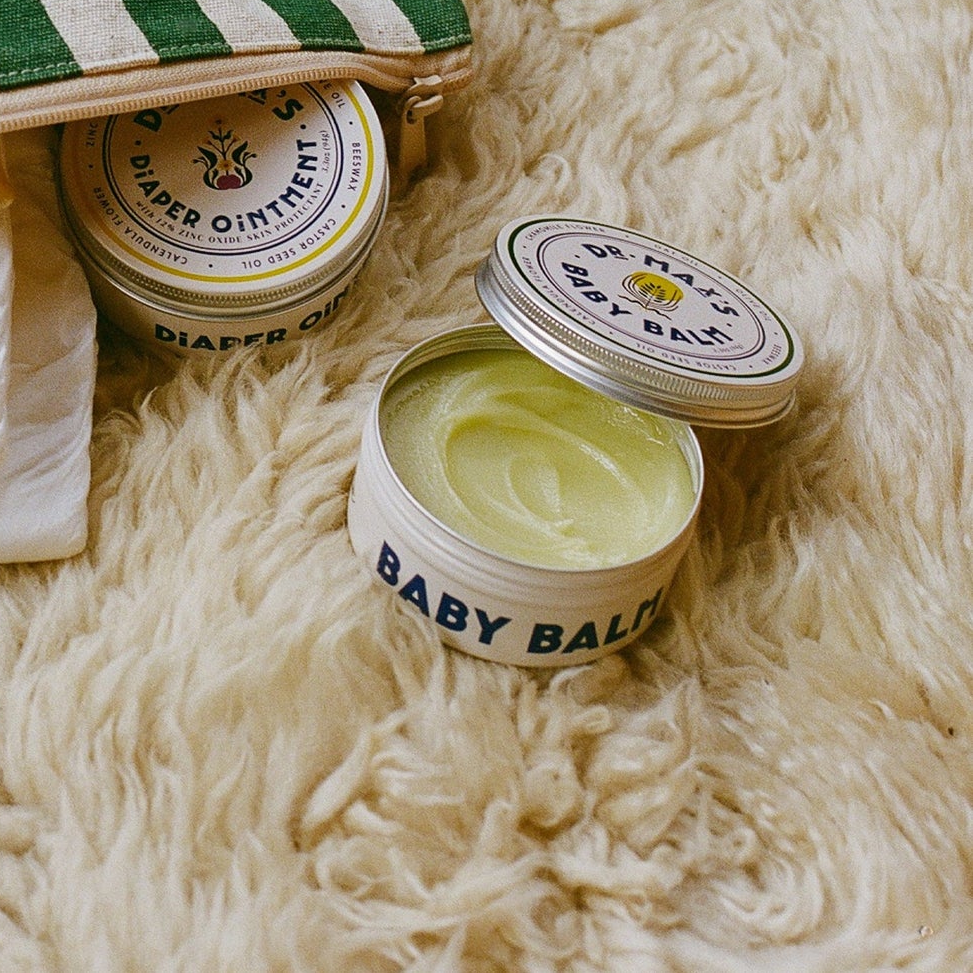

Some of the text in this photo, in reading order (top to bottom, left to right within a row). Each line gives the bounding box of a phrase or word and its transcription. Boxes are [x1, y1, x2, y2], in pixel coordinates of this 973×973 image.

[331, 92, 346, 108] OIL
[348, 143, 361, 191] BEESWAX
[94, 187, 188, 265] CALENDULA FLOWER
[136, 183, 325, 244] with 12% ZINC OXIDE SKIN PROTECTANT
[241, 218, 336, 269] CASTOR SEED OIL
[561, 262, 734, 346] BABY BALM
[636, 341, 737, 371] CASTOR SEED OIL
[377, 539, 664, 654] BABY BALM
